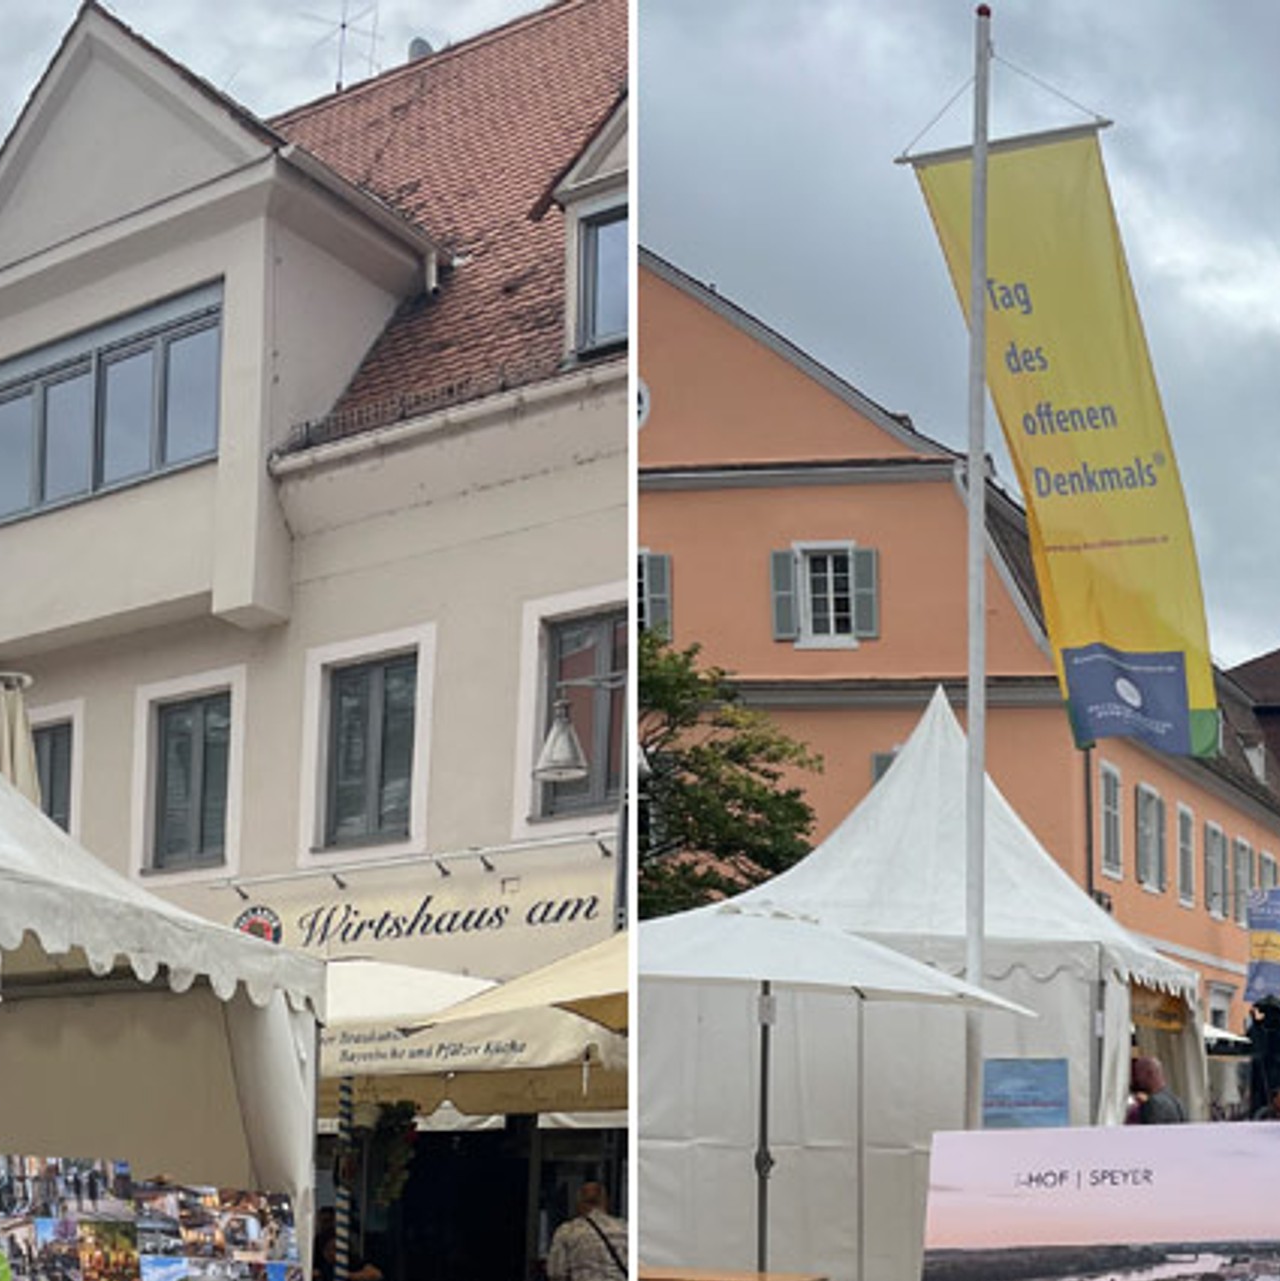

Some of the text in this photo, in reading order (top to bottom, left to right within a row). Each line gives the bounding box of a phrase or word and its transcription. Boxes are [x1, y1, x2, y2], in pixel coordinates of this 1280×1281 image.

[986, 278, 1033, 315] Tag
[1005, 341, 1049, 374] des
[1022, 402, 1118, 436] offenen
[298, 895, 511, 948] Wirtshaus
[524, 894, 600, 925] am
[1089, 1168, 1154, 1188] SPEYER
